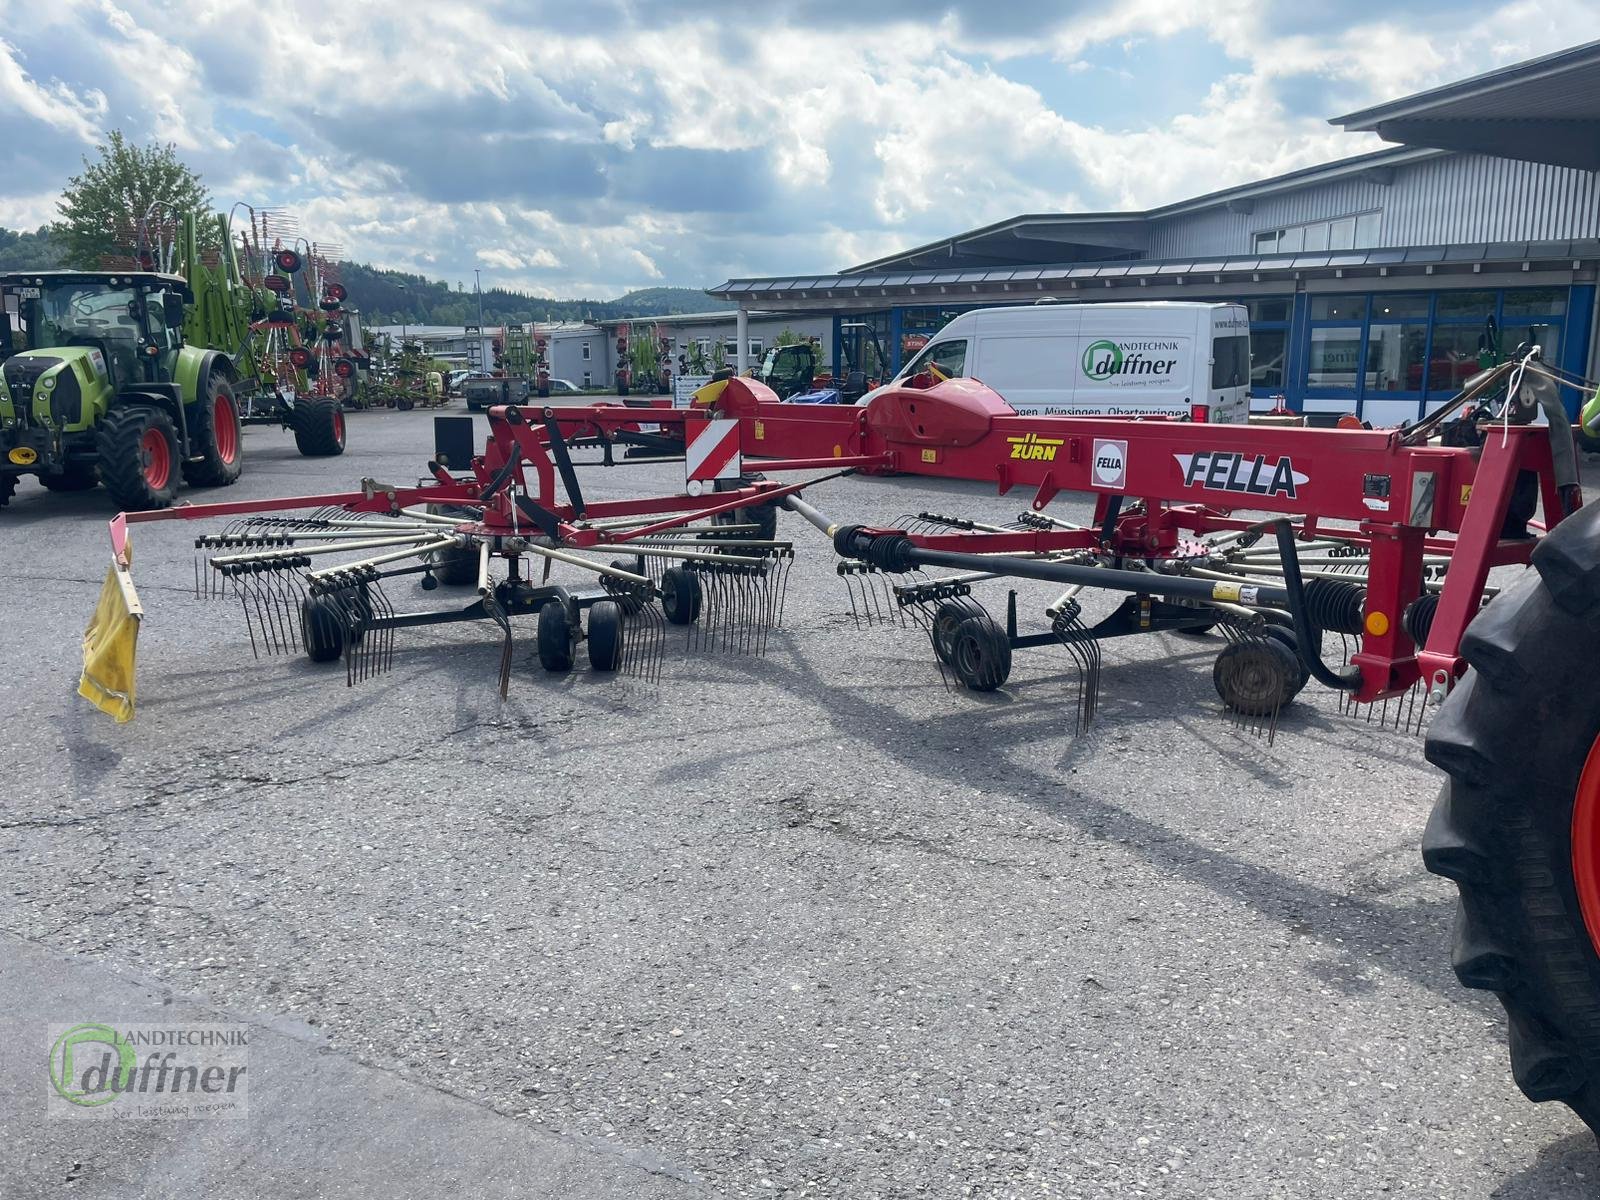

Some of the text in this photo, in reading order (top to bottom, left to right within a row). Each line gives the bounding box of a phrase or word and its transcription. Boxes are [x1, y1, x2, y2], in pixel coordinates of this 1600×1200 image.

[1112, 341, 1179, 352] LANDTECHNIK
[1095, 352, 1177, 375] duffner
[1096, 457, 1122, 470] FELLA
[1184, 451, 1297, 499] FELLA
